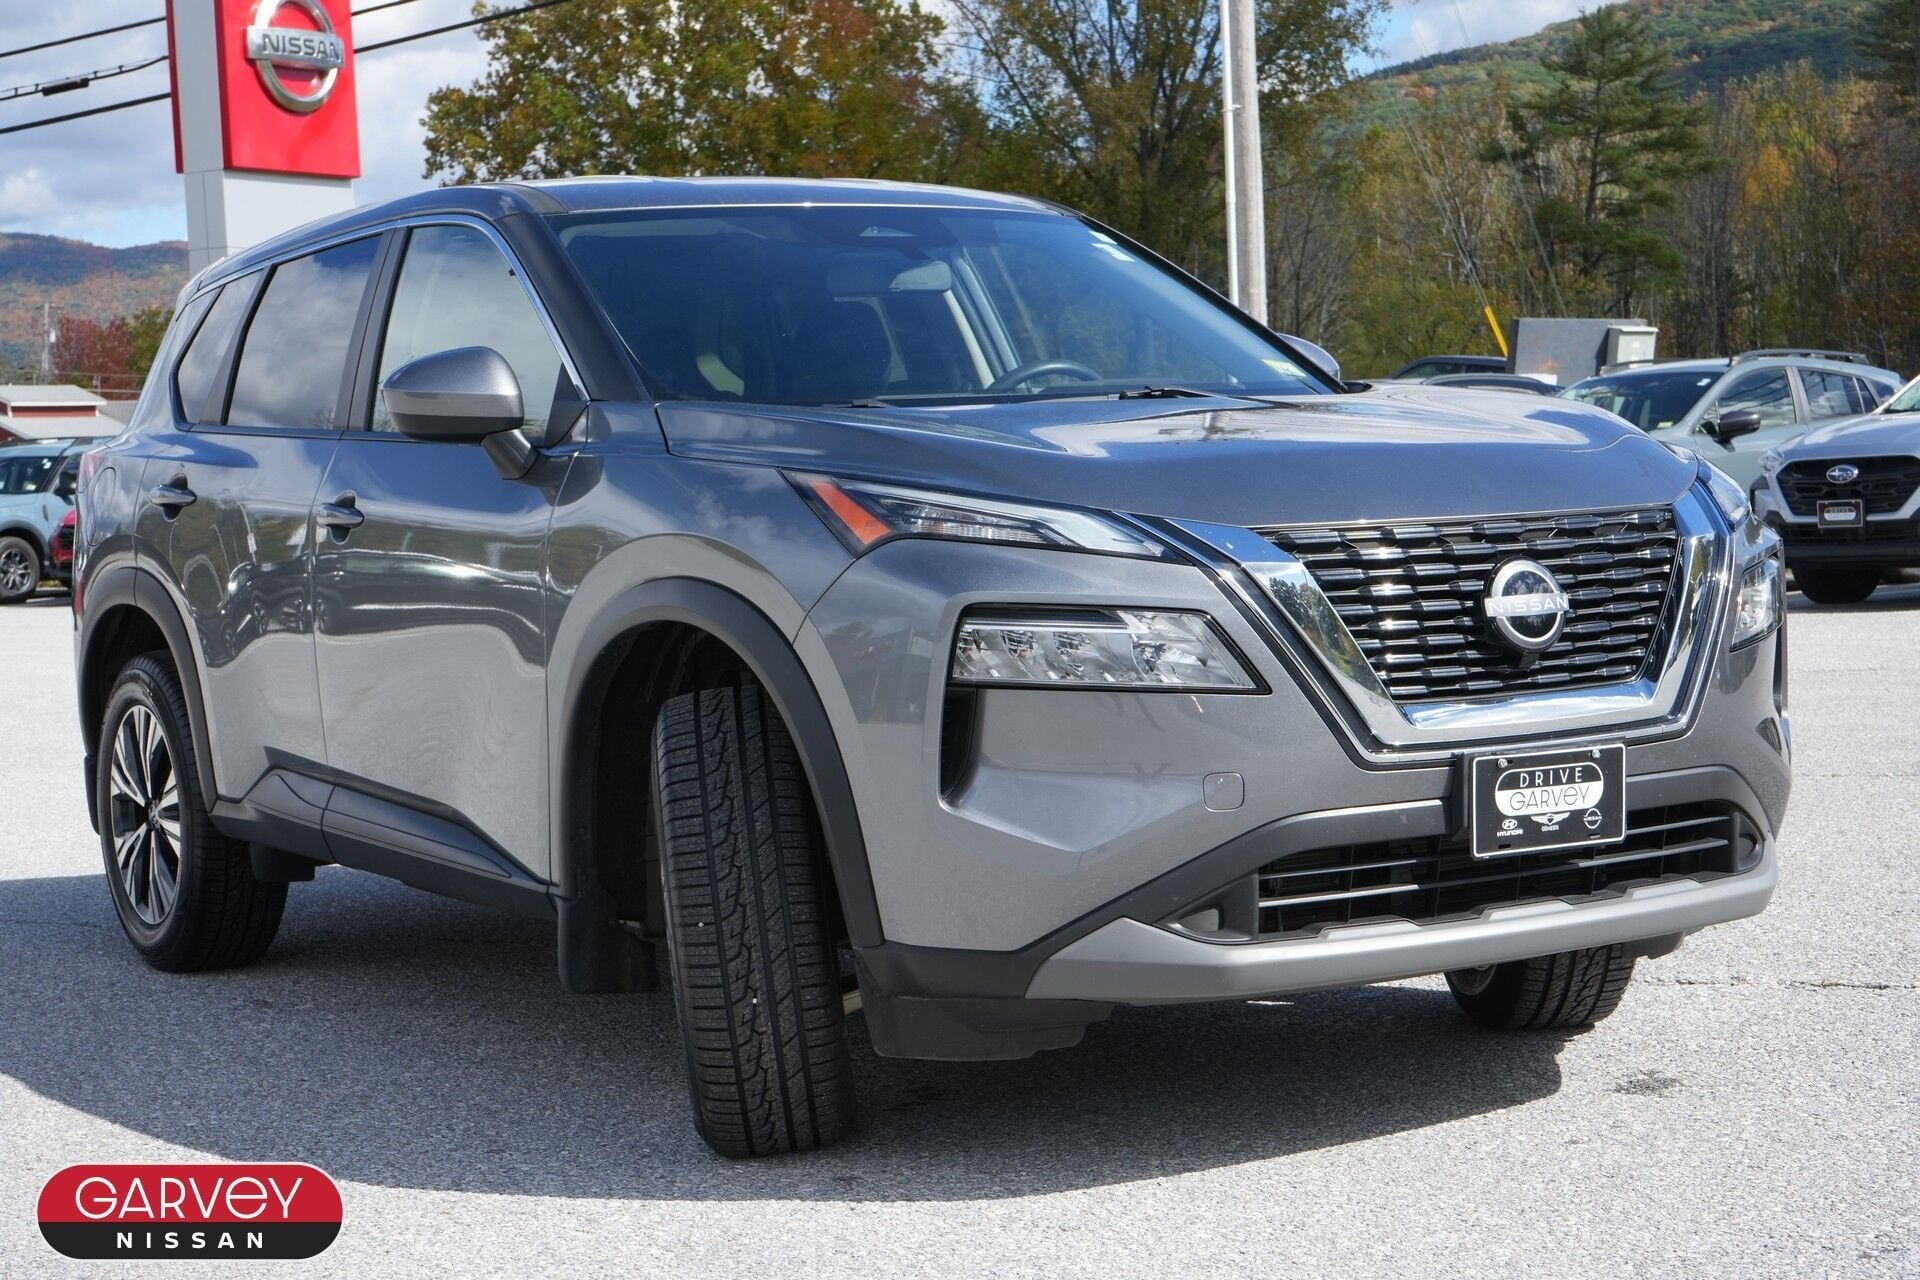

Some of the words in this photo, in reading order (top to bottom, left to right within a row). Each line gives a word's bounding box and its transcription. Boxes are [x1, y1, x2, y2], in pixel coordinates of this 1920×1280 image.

[262, 33, 342, 62] NISSAN
[1488, 594, 1568, 614] NISSAN
[1520, 767, 1582, 787] DRIVE
[1497, 828, 1523, 837] HYUNDAI
